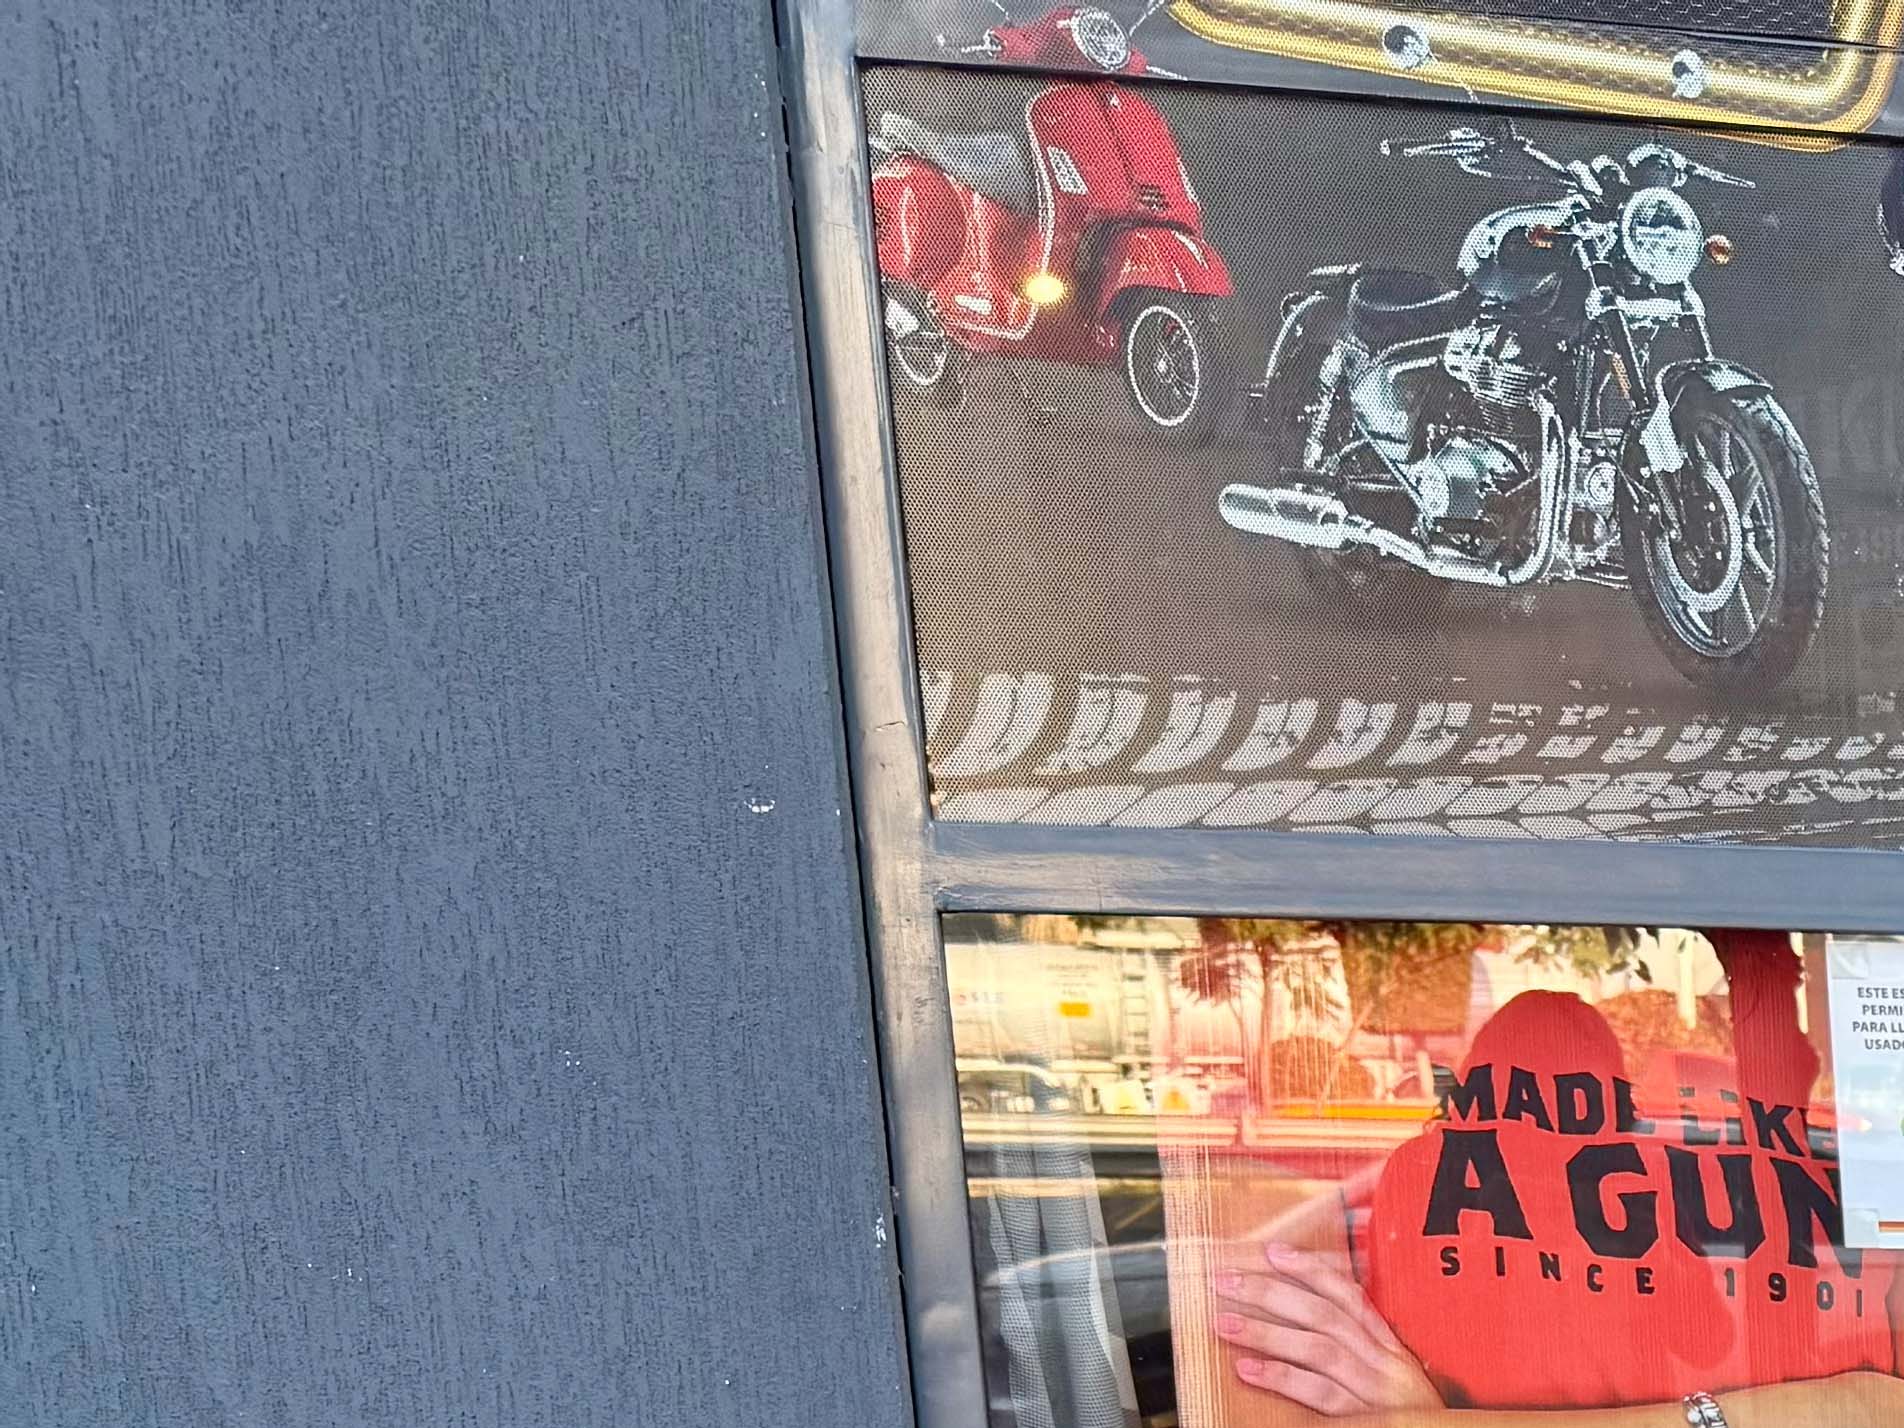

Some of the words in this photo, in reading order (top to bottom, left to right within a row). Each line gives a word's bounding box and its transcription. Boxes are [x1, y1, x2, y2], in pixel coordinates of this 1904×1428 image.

[1852, 1021, 1888, 1034] PARA
[1857, 986, 1889, 1000] ESTE
[1440, 1063, 1656, 1135] MADE
[1422, 1128, 1534, 1240] A
[1566, 1142, 1863, 1279] GUN
[1441, 1247, 1656, 1295] SINCE
[1725, 1267, 1863, 1318] 1901
